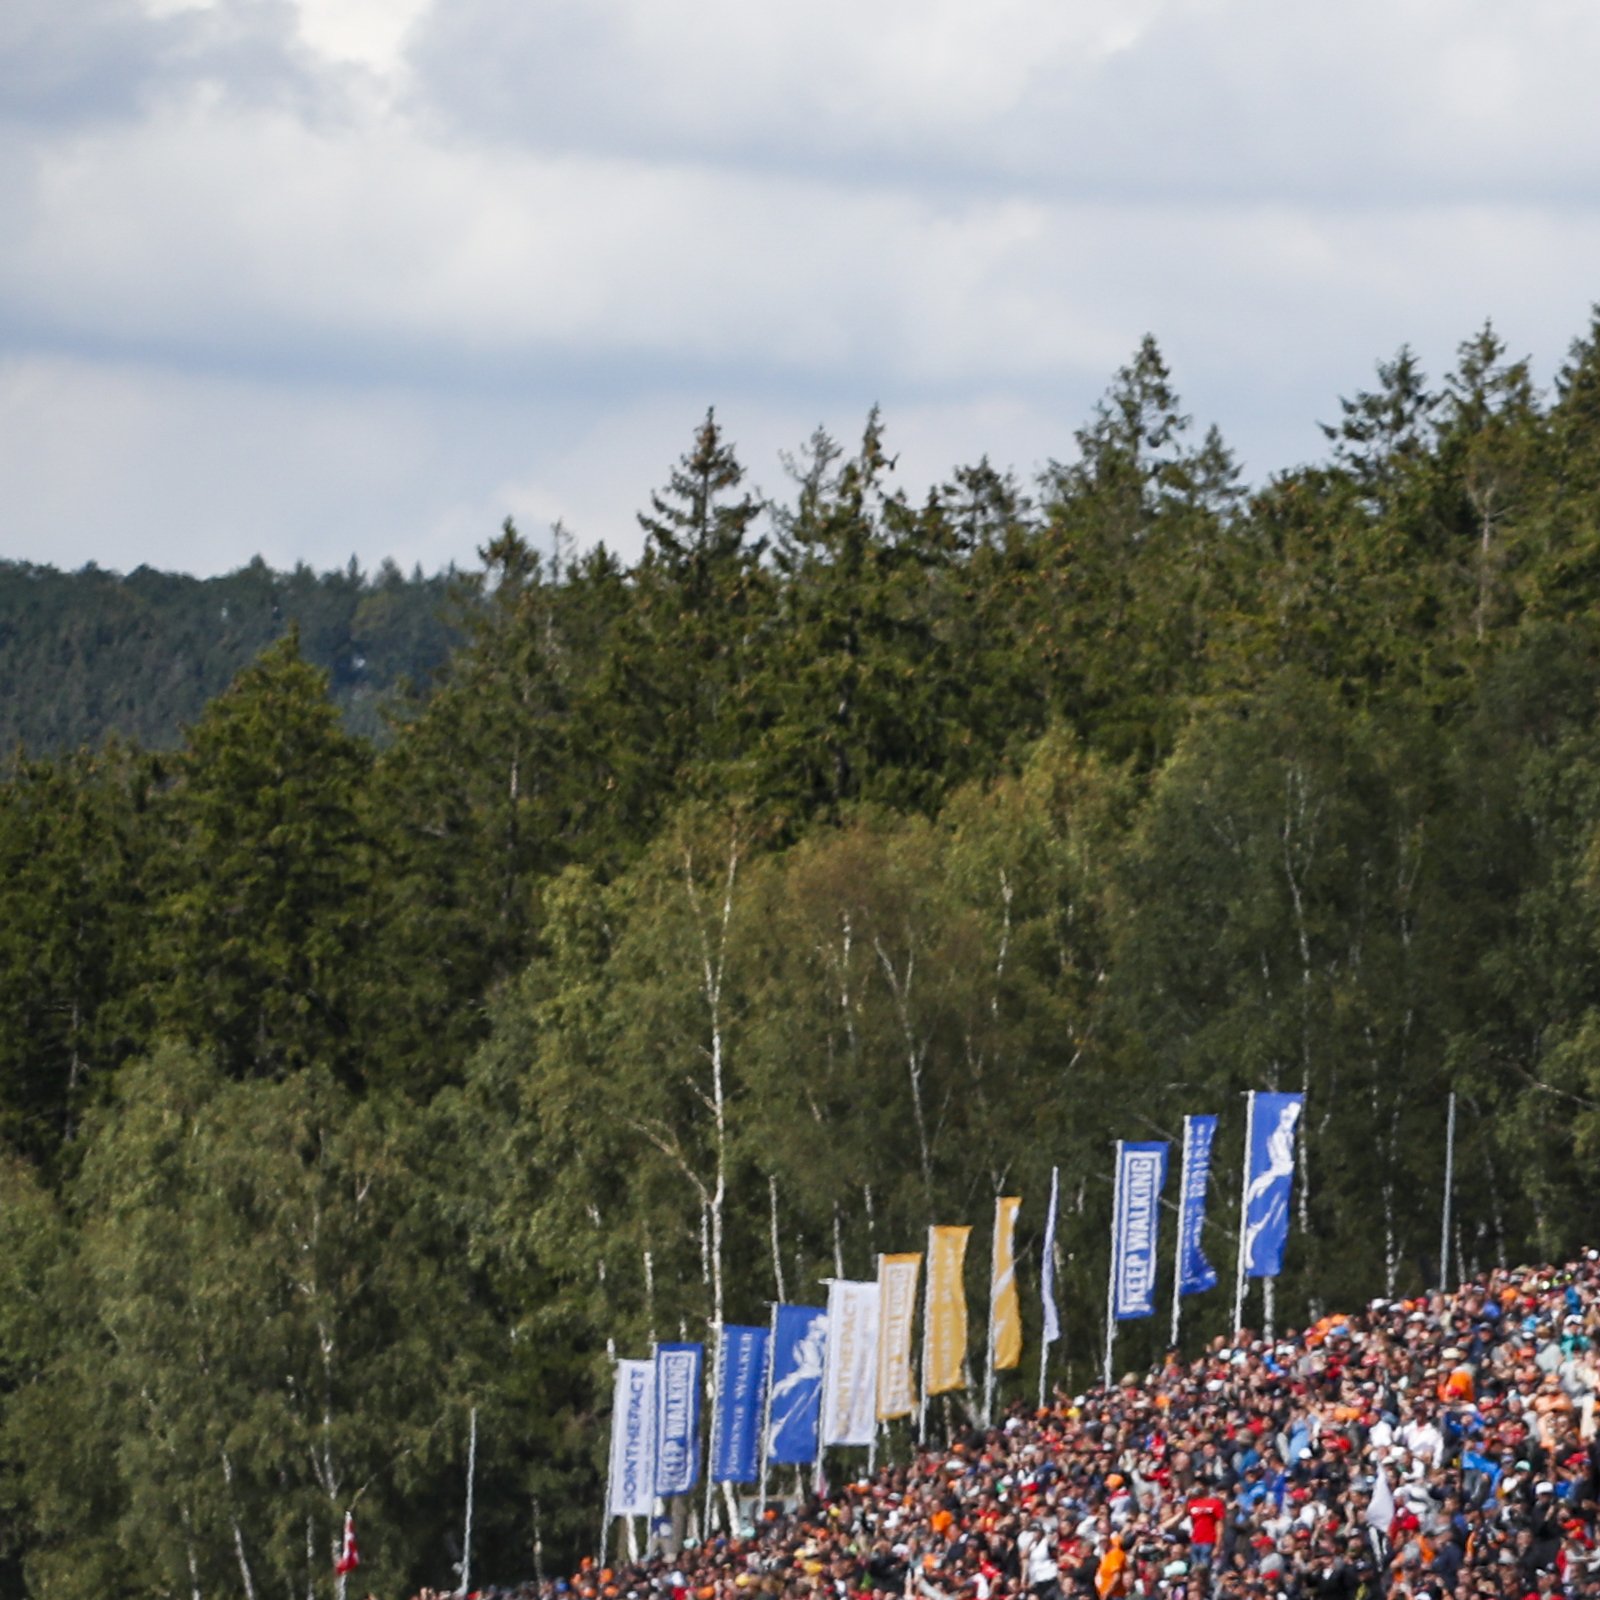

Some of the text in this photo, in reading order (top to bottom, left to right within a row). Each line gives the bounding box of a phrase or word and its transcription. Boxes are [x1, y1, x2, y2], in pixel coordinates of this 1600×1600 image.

[1125, 1159, 1153, 1304] KEEP WALKING
[665, 1357, 690, 1438] WALKING
[734, 1333, 753, 1400] WALKER
[624, 1369, 644, 1505] JOINTHEPACT
